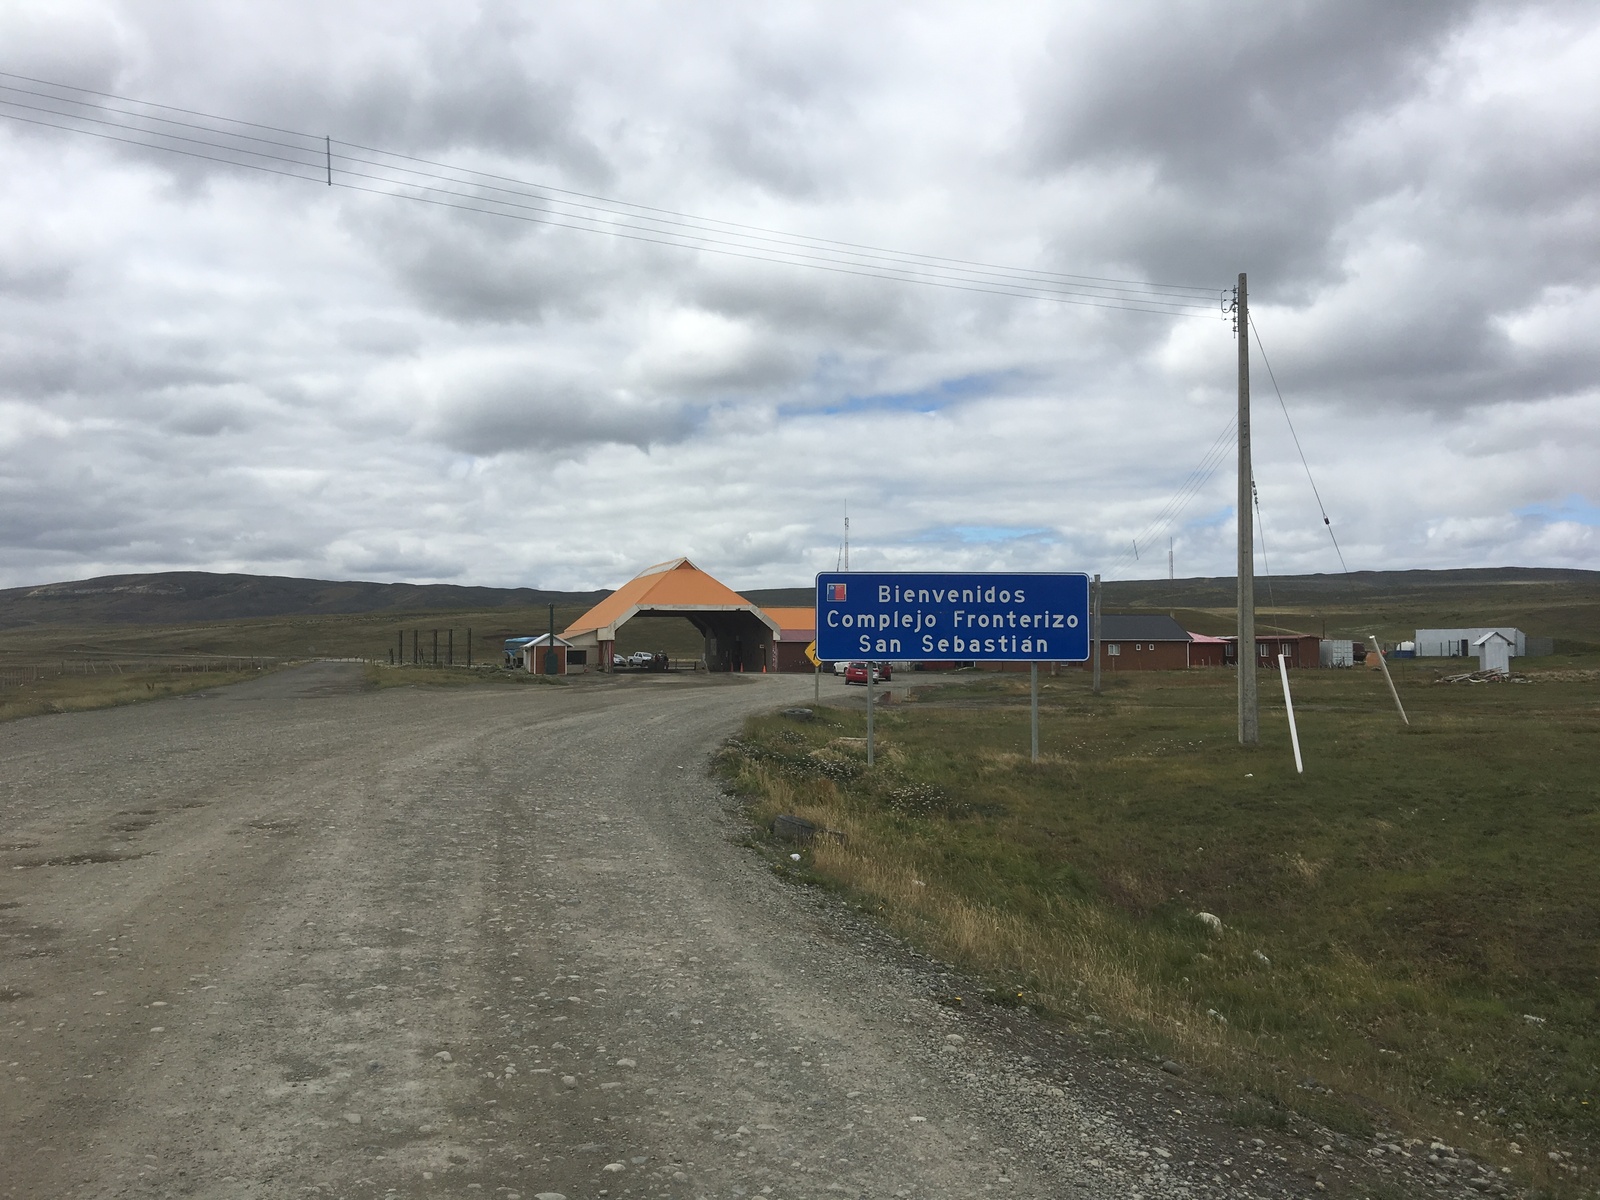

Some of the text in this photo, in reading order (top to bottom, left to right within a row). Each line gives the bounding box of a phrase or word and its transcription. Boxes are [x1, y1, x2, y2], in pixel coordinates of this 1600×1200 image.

[878, 585, 1026, 604] Bienvenidos
[827, 609, 1079, 633] Complejo Fronterizo
[859, 634, 1048, 653] San Sebastián
